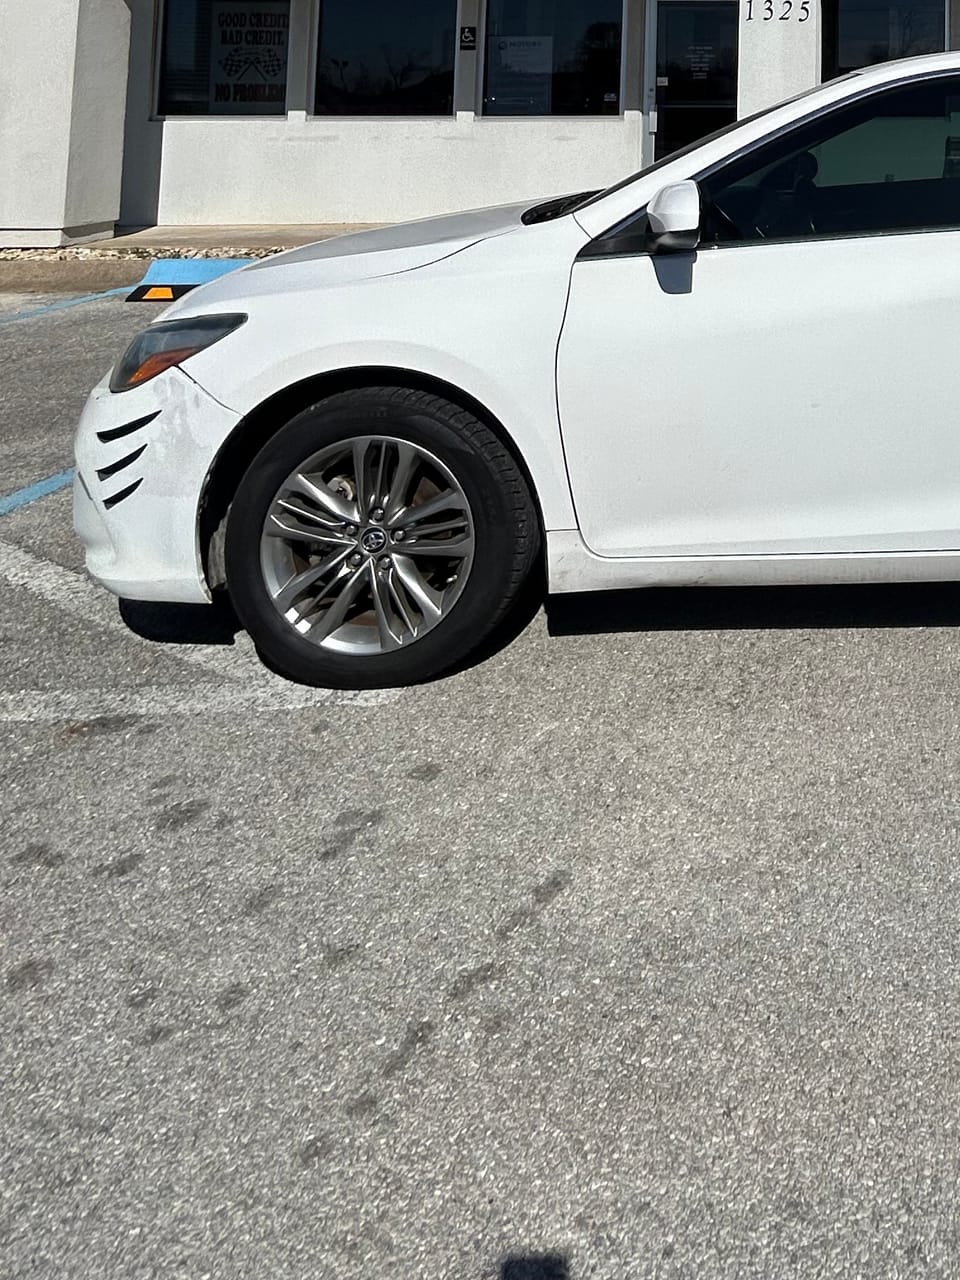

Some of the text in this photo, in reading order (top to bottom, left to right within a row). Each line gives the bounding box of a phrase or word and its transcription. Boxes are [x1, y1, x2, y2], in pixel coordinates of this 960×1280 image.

[218, 12, 247, 28] GOOD
[746, 0, 810, 22] 1325
[220, 30, 243, 45] BAD
[214, 83, 232, 103] NO
